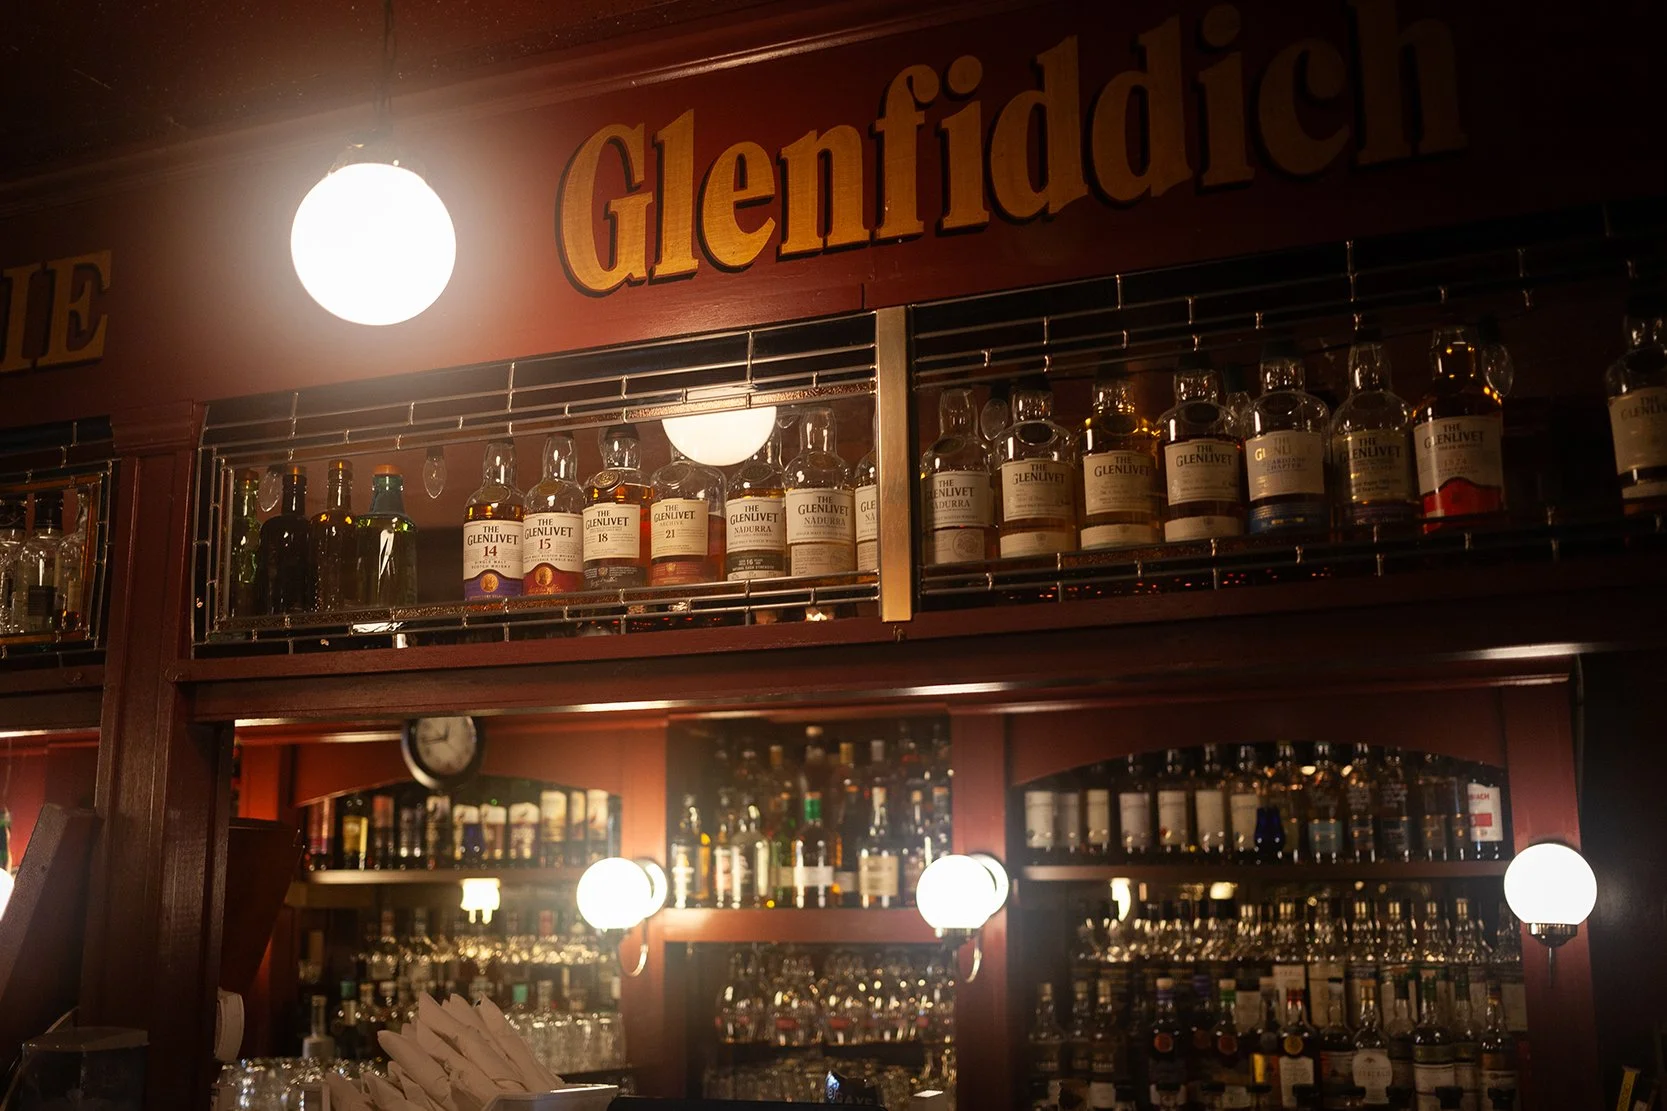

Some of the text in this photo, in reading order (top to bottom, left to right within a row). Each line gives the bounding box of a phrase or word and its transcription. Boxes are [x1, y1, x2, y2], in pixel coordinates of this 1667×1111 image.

[559, 0, 1468, 292] Glenfiddich
[1443, 422, 1461, 432] THE
[1195, 444, 1214, 454] THE
[1339, 445, 1401, 463] GENLIVET
[1114, 455, 1132, 464] THE
[1176, 453, 1232, 467] GLENLIVET
[1030, 463, 1047, 472] THE
[1094, 465, 1151, 477] GLENLIVET
[939, 479, 954, 487] THE
[1013, 472, 1065, 486] GLENLIVET
[816, 496, 832, 504] THE
[664, 504, 679, 512] THE
[744, 504, 760, 512] THE
[798, 504, 849, 517] GLENLIVET
[597, 510, 610, 518] THE
[654, 510, 696, 523] GLENLIVET
[730, 512, 779, 526] GLENLIVET
[537, 518, 554, 527] THE
[585, 517, 630, 530] GLENLIVET
[482, 525, 500, 534] THE
[524, 526, 574, 540] GLENLIVET
[665, 530, 676, 539] 21
[467, 533, 519, 547] GLENLIVET
[598, 533, 608, 543] 18
[538, 538, 552, 550] 15
[483, 545, 498, 557] 14
